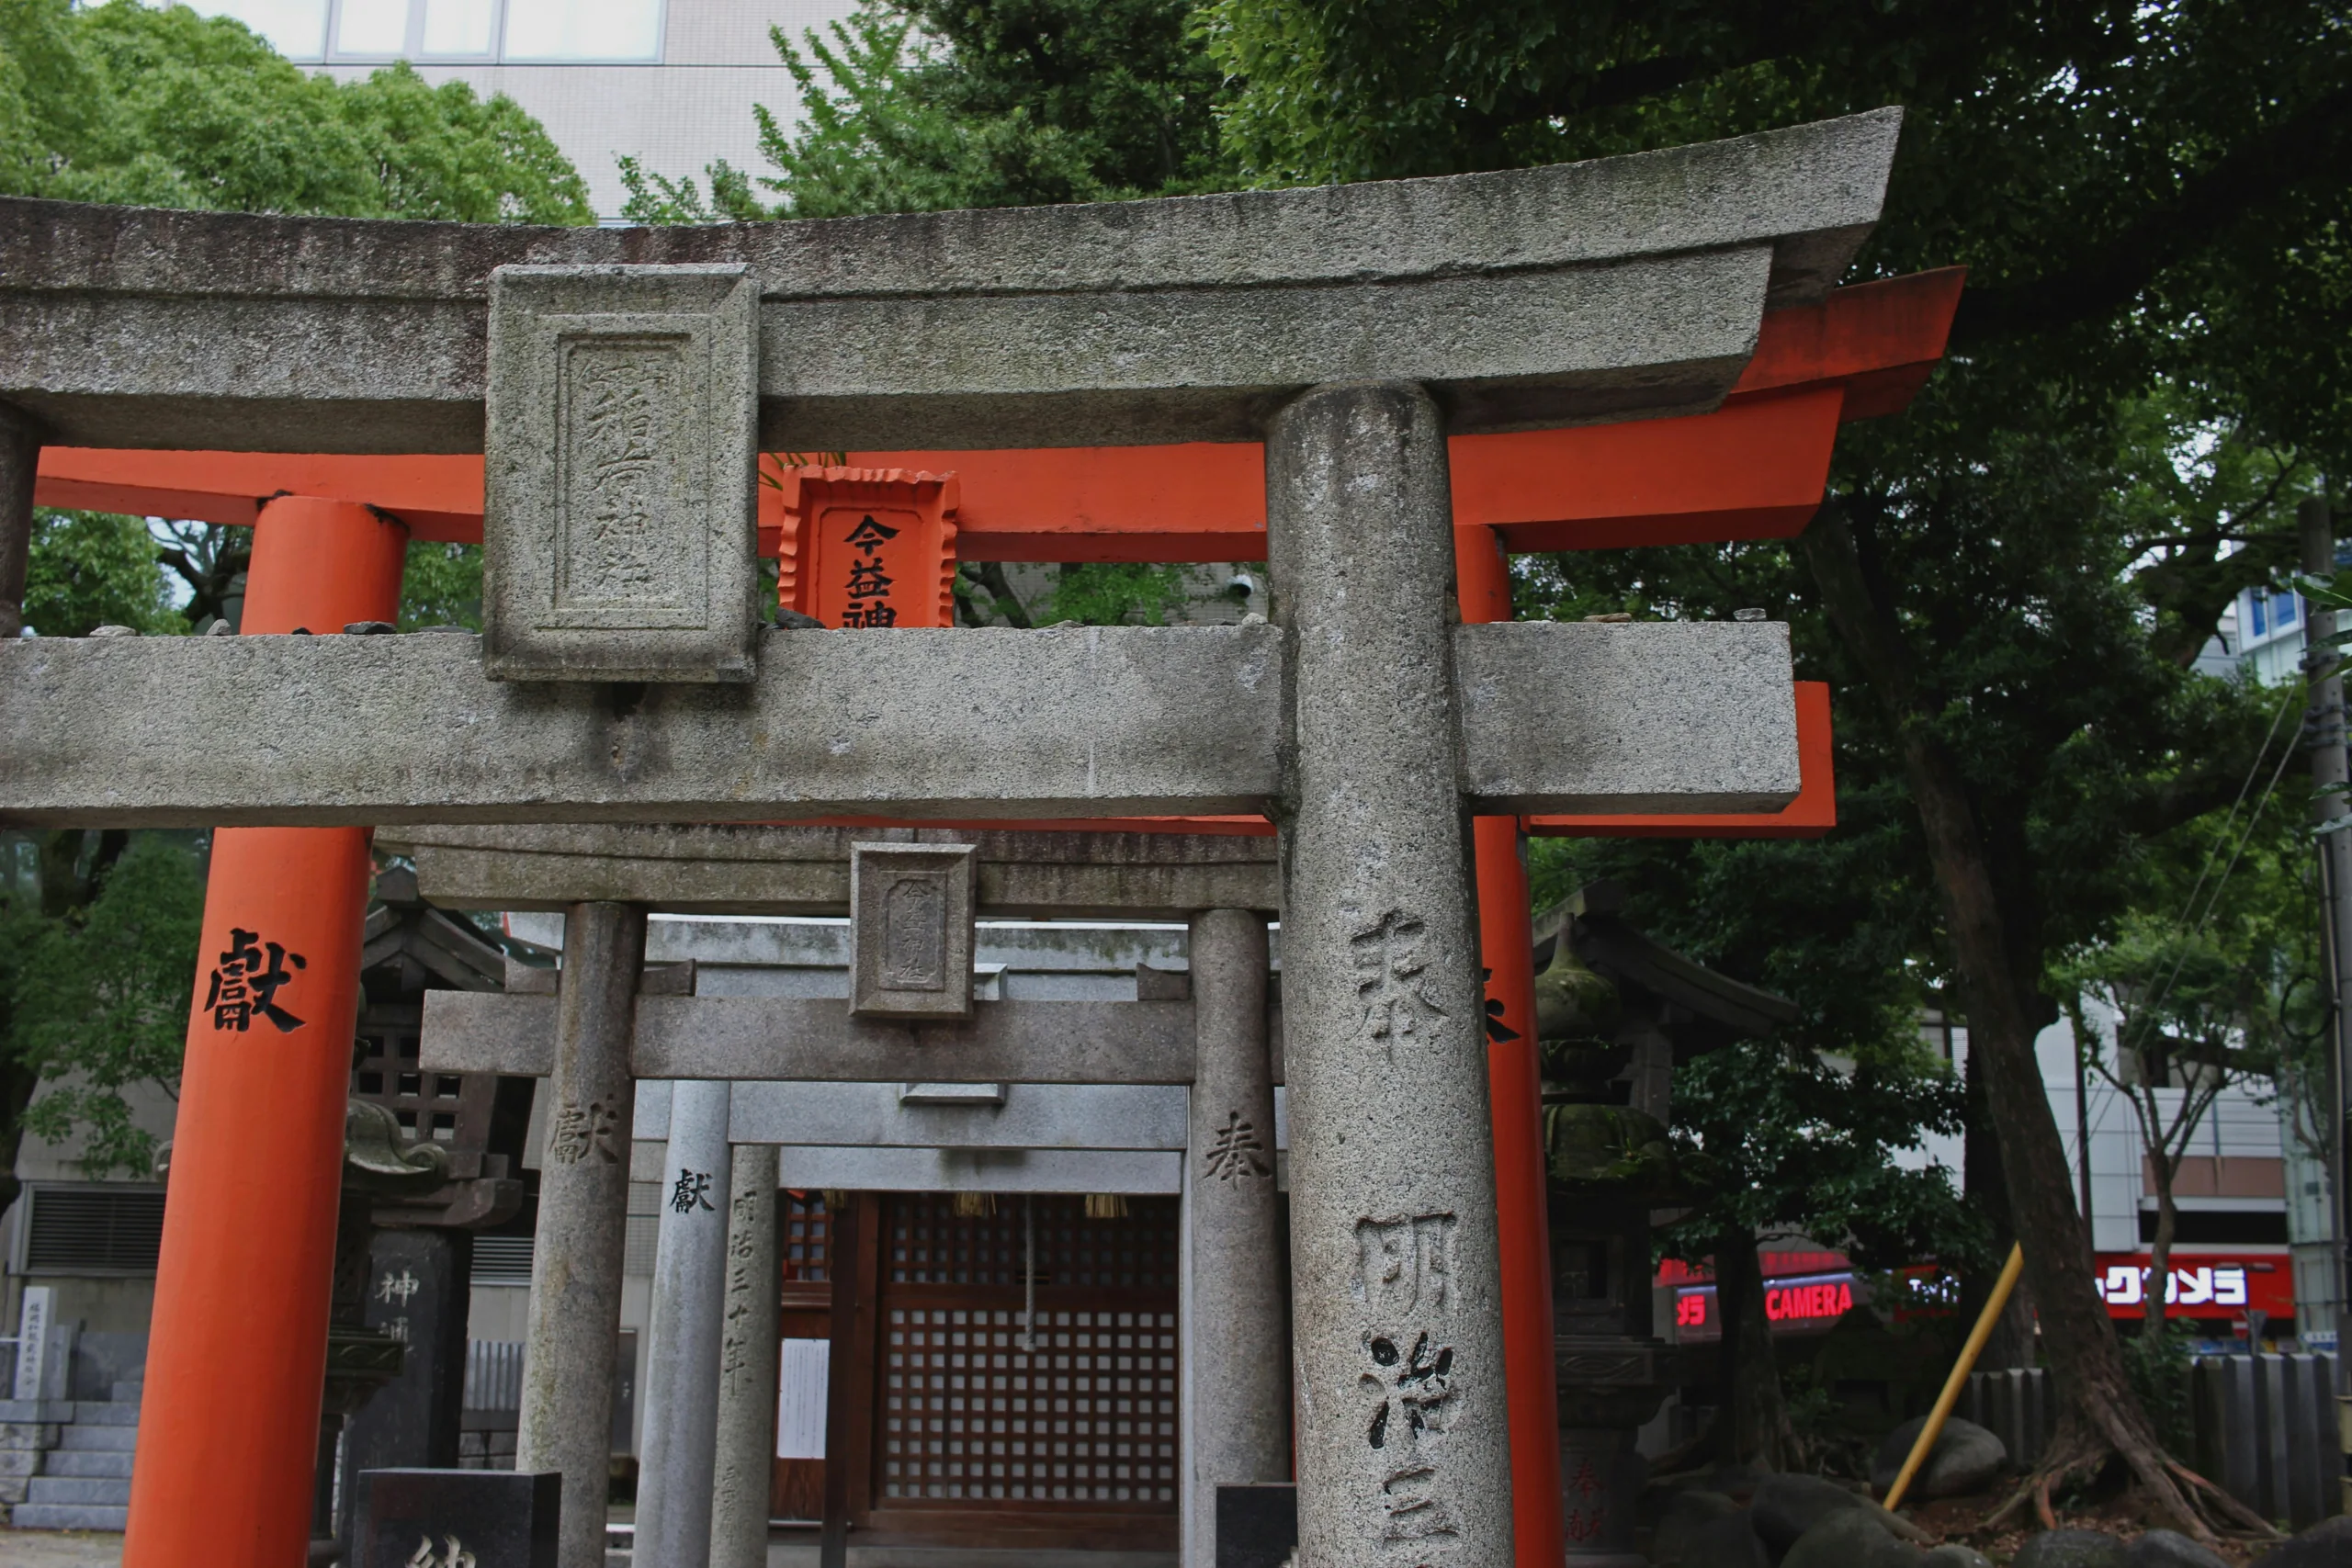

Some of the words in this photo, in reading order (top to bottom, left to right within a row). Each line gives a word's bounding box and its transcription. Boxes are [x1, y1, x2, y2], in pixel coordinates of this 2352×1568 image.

[842, 513, 901, 628] 今益神
[1350, 907, 1450, 1066] 奉
[1203, 1110, 1272, 1191] 奉
[1765, 1282, 1854, 1321] CAMERA
